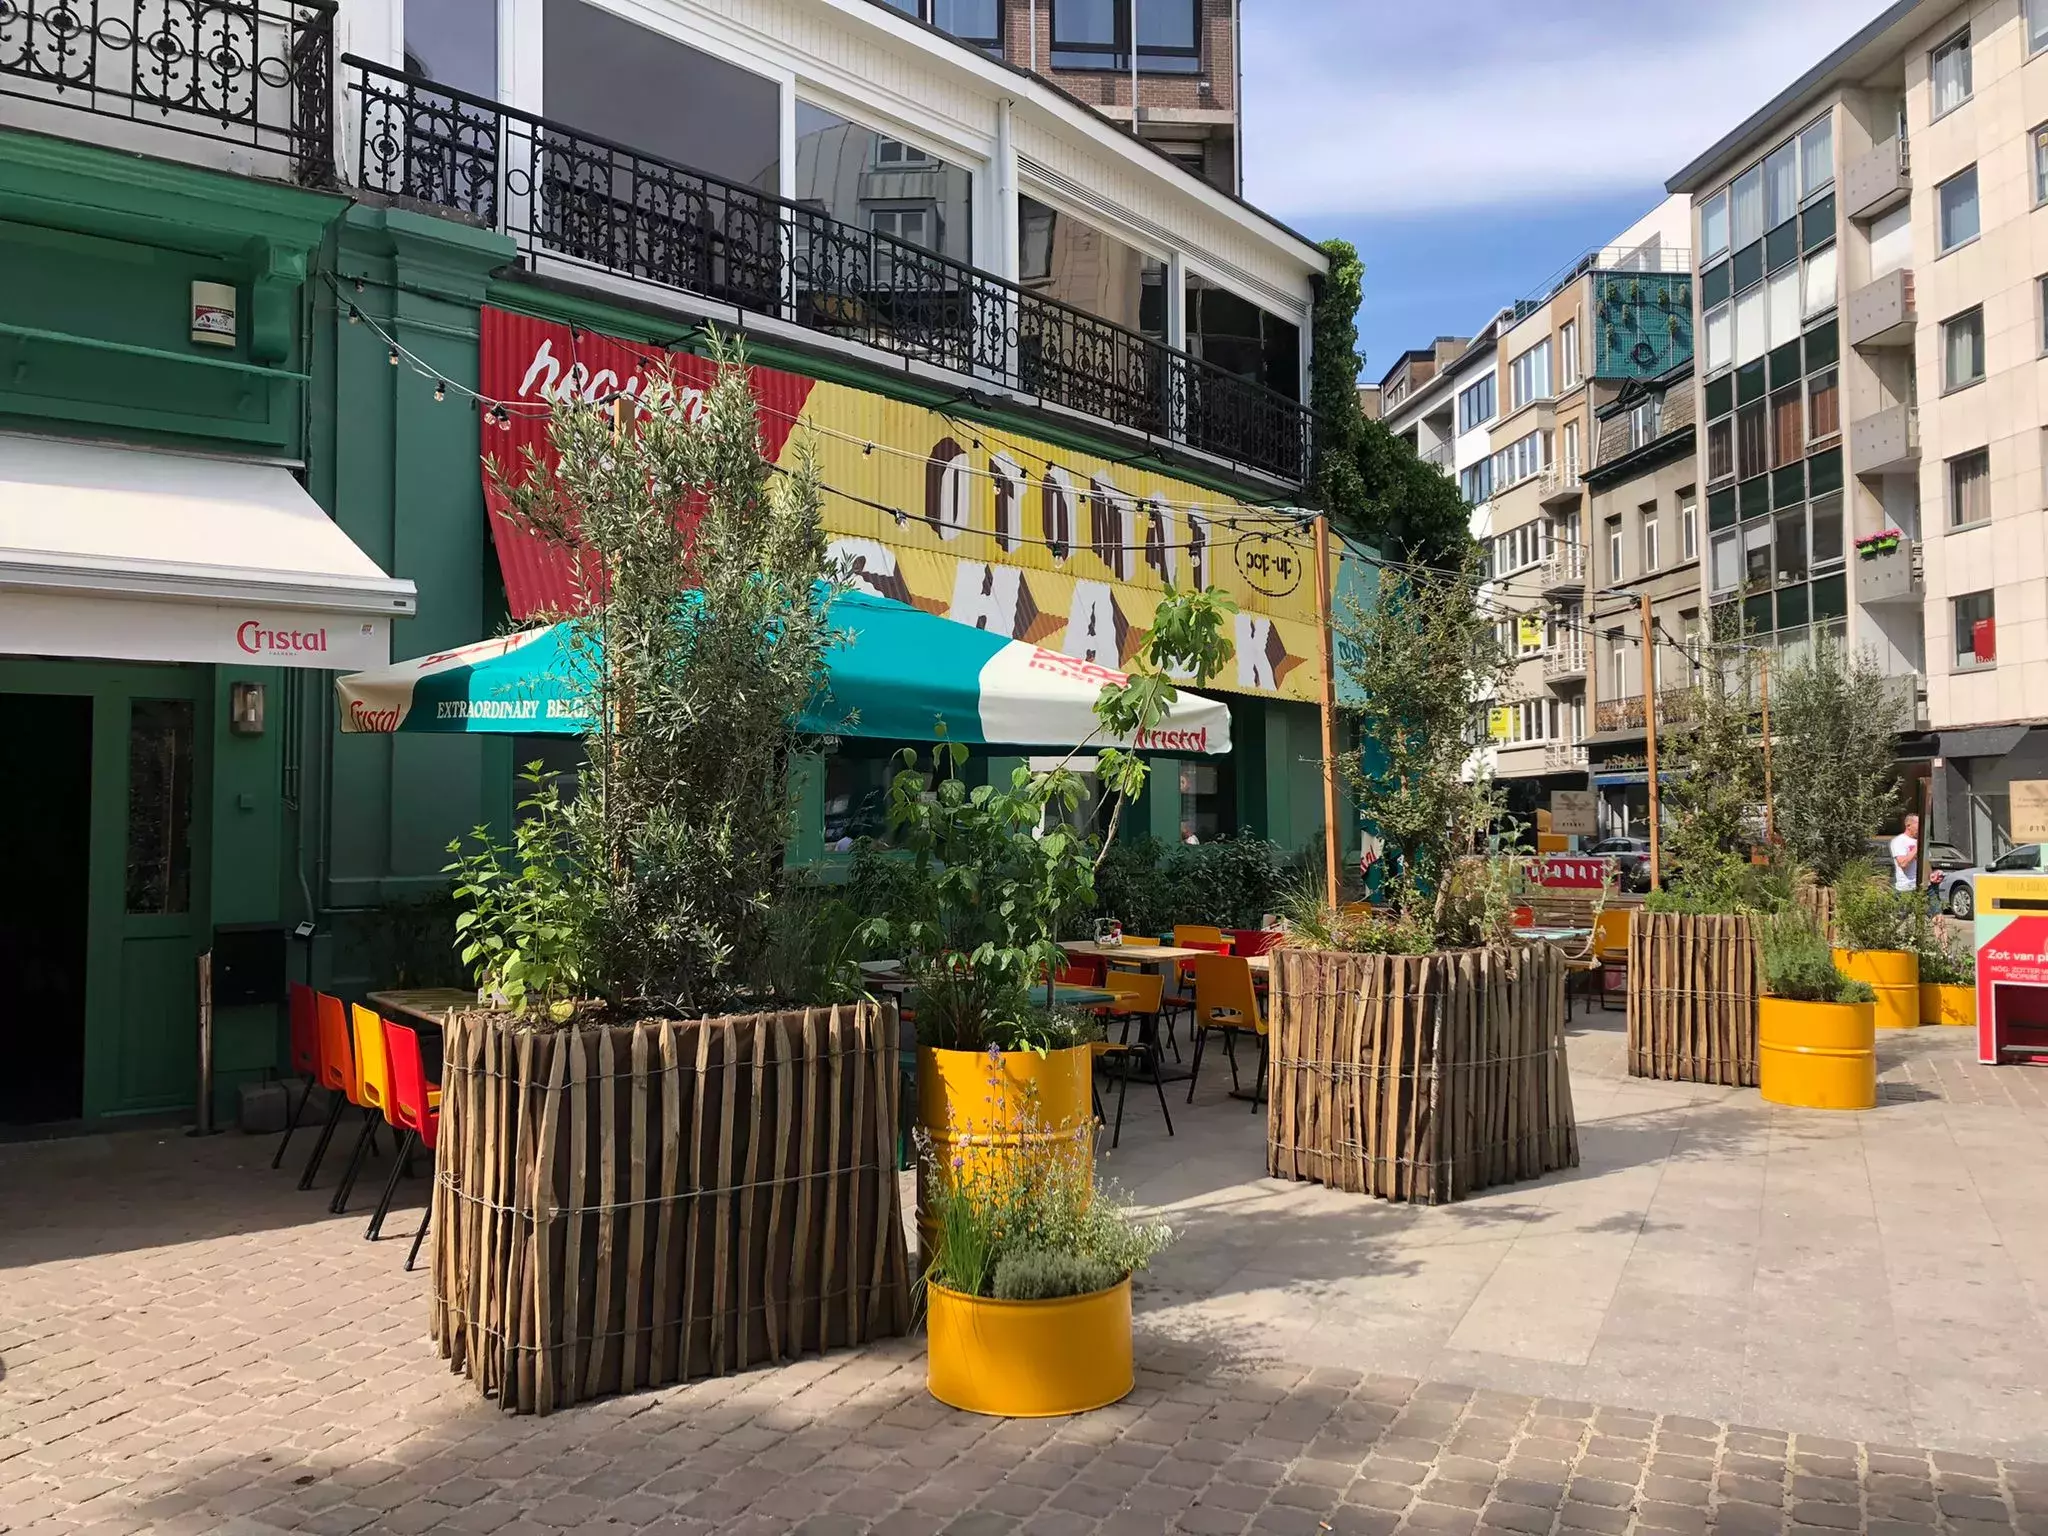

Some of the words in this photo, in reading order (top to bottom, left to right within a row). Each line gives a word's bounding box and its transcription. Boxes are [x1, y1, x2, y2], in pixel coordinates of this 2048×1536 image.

[925, 436, 1212, 595] OTOMAT
[1246, 551, 1292, 581] pop-up
[236, 620, 328, 655] Cristal
[350, 699, 402, 732] Cristal
[437, 700, 540, 720] EXTRAORDINARY
[1988, 949, 2011, 960] Zot
[2013, 953, 2035, 961] van
